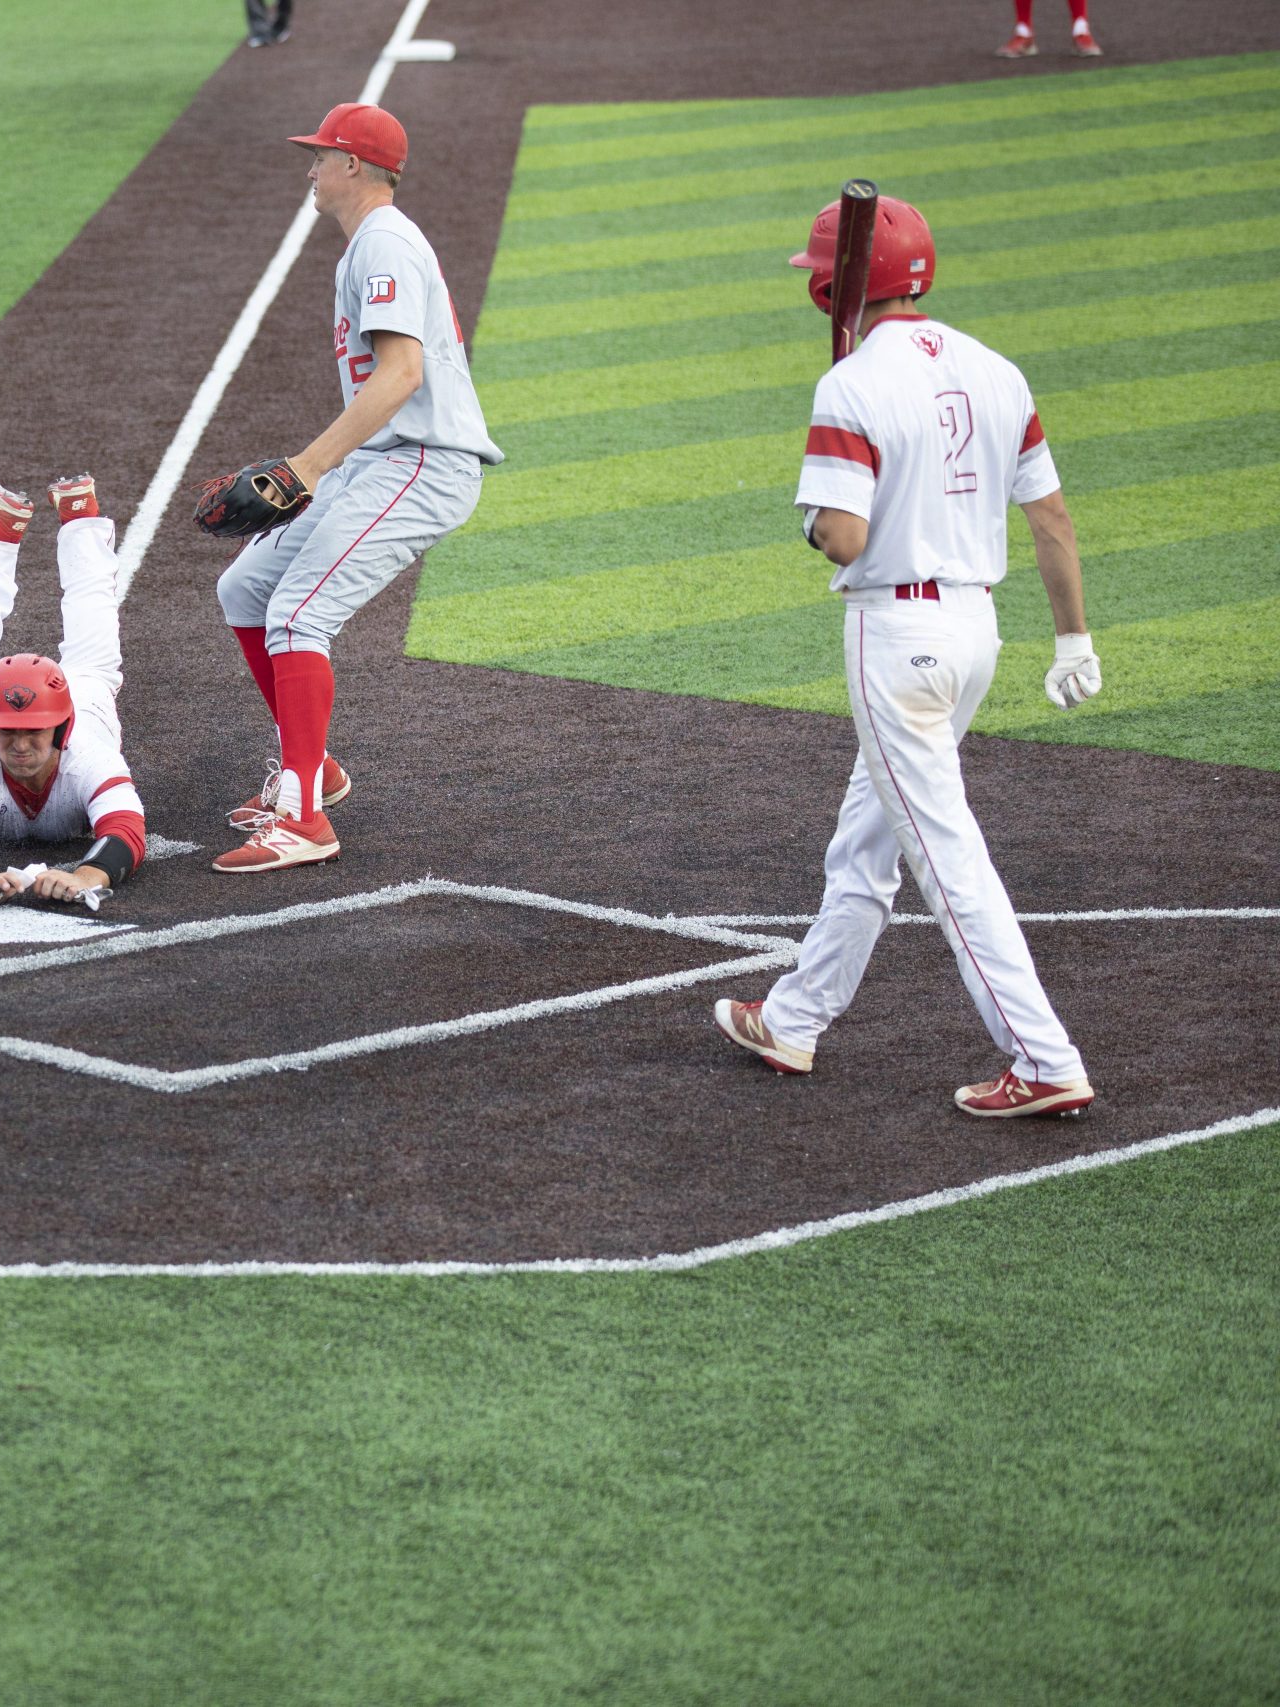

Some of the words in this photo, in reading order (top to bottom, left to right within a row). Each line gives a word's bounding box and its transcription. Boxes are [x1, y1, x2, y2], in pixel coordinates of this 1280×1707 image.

[367, 274, 396, 304] D
[909, 281, 922, 294] 31
[934, 390, 978, 496] 2
[745, 1012, 765, 1041] N
